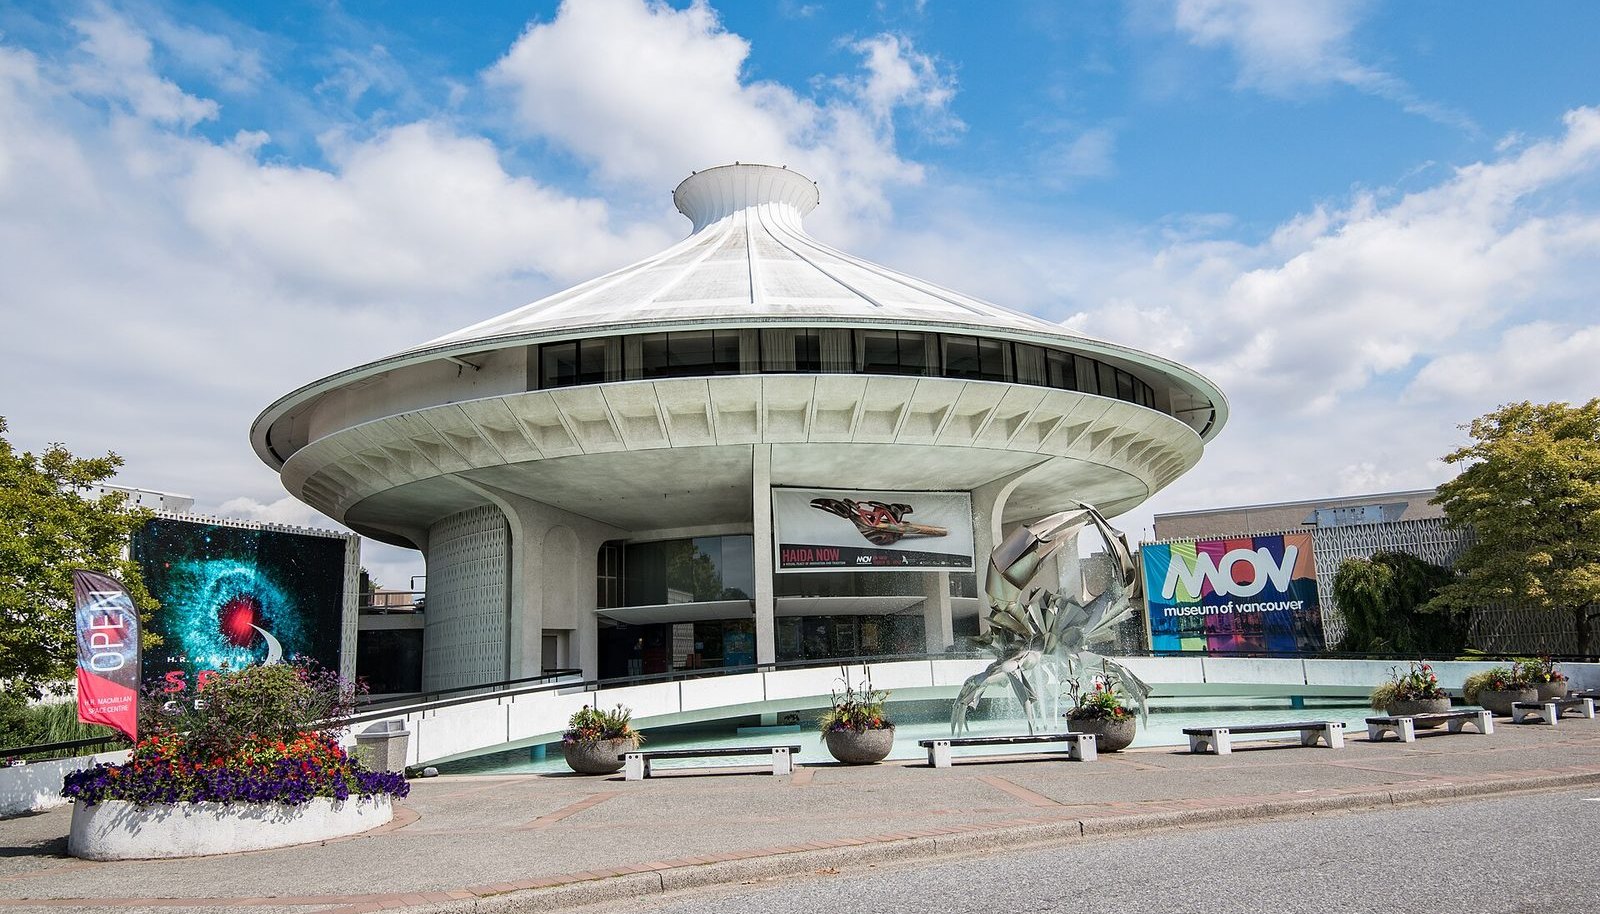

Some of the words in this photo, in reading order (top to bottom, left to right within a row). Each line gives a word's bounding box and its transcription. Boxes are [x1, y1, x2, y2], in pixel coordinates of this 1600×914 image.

[782, 549, 814, 562] HAIDA
[816, 548, 840, 561] NOW
[1162, 545, 1297, 599] MOV
[1164, 605, 1218, 617] museum
[1219, 601, 1234, 614] of
[1235, 600, 1304, 613] vancouver
[89, 590, 124, 672] OPEN
[97, 695, 132, 705] MACMILLAN
[106, 704, 128, 713] CENTRE
